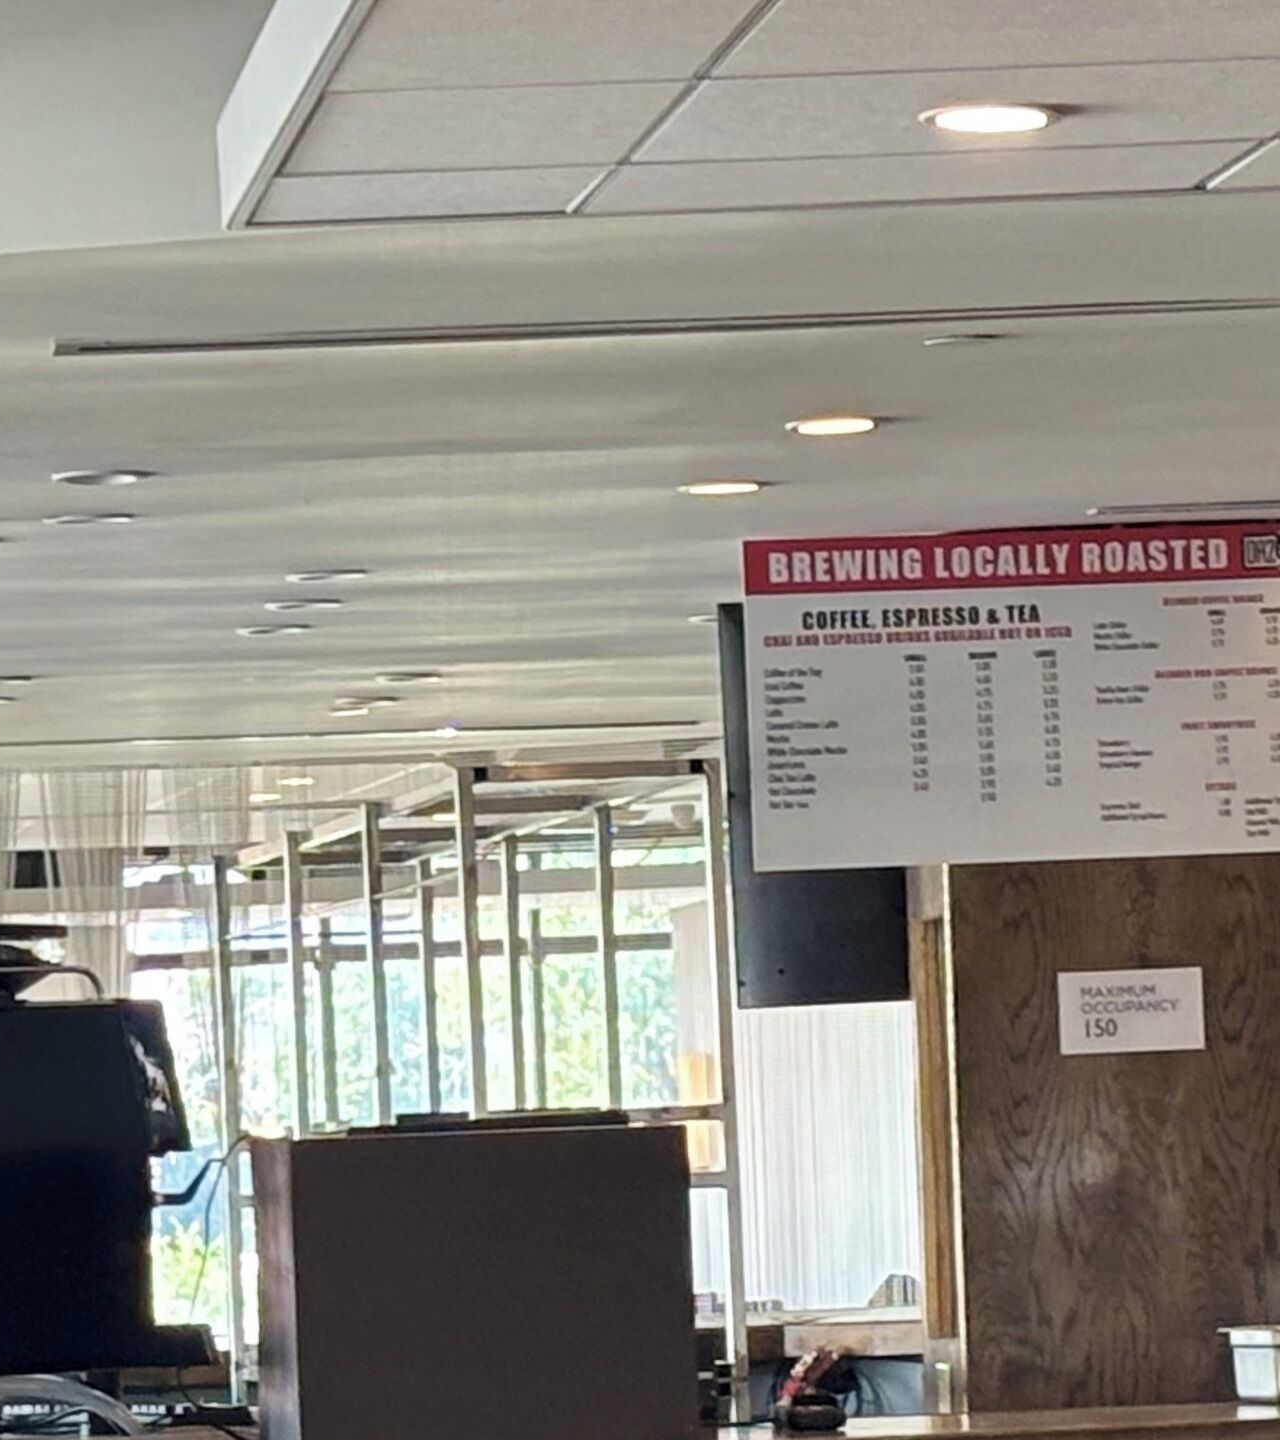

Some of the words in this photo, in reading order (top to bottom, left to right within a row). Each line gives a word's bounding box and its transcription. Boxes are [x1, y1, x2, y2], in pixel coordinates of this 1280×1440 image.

[768, 548, 923, 584] BREWING
[933, 543, 1071, 579] LOCALLY
[1080, 538, 1230, 574] ROASTED
[801, 608, 877, 631] COFFEE,
[881, 605, 981, 629] ESPRESSO
[986, 607, 1000, 625] &
[1004, 603, 1041, 624] TEA
[1079, 984, 1157, 999] MAXIMUM
[1080, 998, 1180, 1015] OCCUPANCY
[1085, 1017, 1119, 1039] 150
